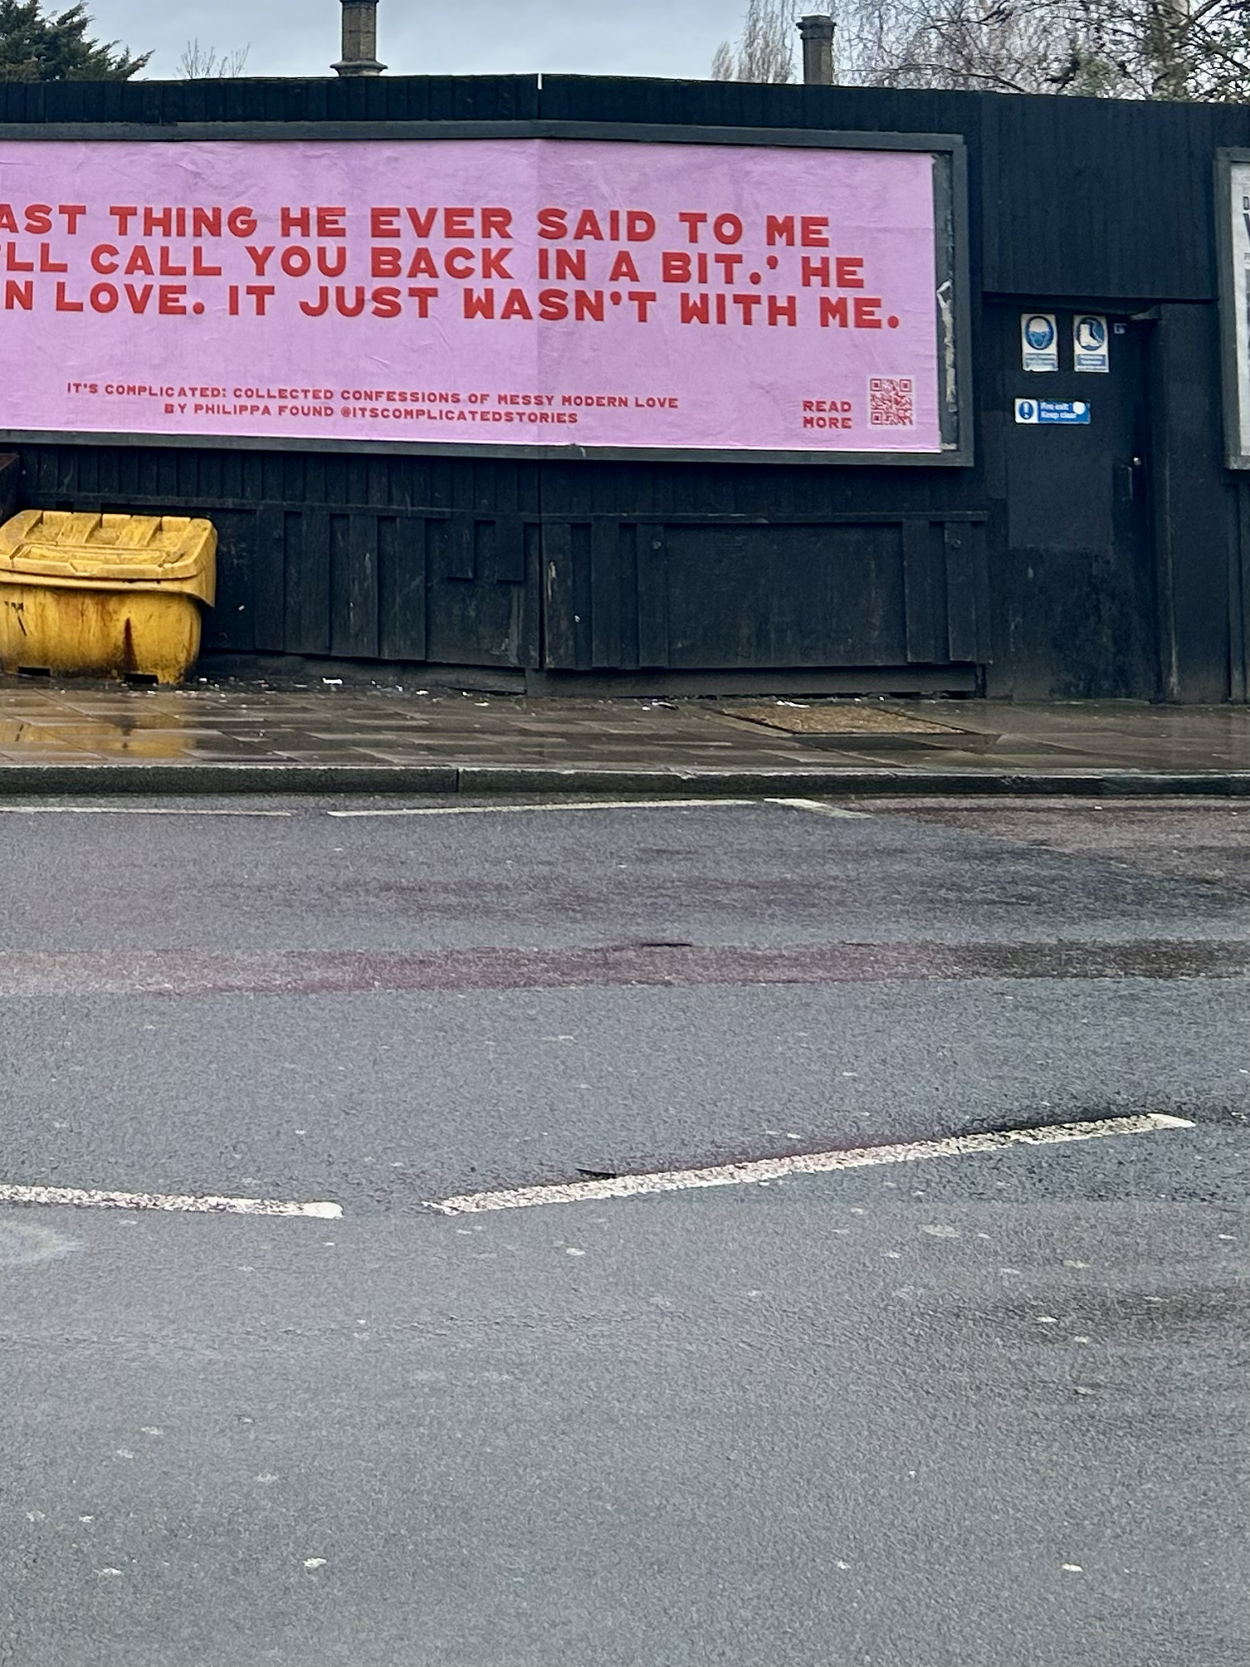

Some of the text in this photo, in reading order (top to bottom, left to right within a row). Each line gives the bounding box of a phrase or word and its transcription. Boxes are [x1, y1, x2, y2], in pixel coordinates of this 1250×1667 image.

[109, 205, 257, 238] THING
[280, 206, 347, 237] HE
[370, 206, 513, 239] EVER
[537, 207, 656, 242] SAID
[678, 211, 743, 245] TO
[766, 214, 829, 247] ME
[90, 243, 222, 277] CALL
[246, 244, 347, 278] YOU
[370, 246, 513, 279] BACK
[538, 247, 586, 280] IN
[609, 250, 639, 282] A
[661, 251, 778, 285] BIT.'
[801, 255, 864, 289] HE
[55, 280, 205, 315] LOVE.
[228, 284, 275, 316] IT
[299, 285, 438, 318] JUST
[463, 287, 657, 323] WASN'T
[680, 291, 797, 327] WITH
[819, 296, 899, 329] ME.
[66, 382, 680, 409] IT'S COMPLICATED: COLLECTED CONFESSIONS OF MESSY MODERN LOVE
[802, 399, 851, 412] READ
[163, 401, 579, 424] BY PHILIPPA FOUND @ITSCOMPLICATEDSTORIES
[803, 416, 850, 428] MORE
